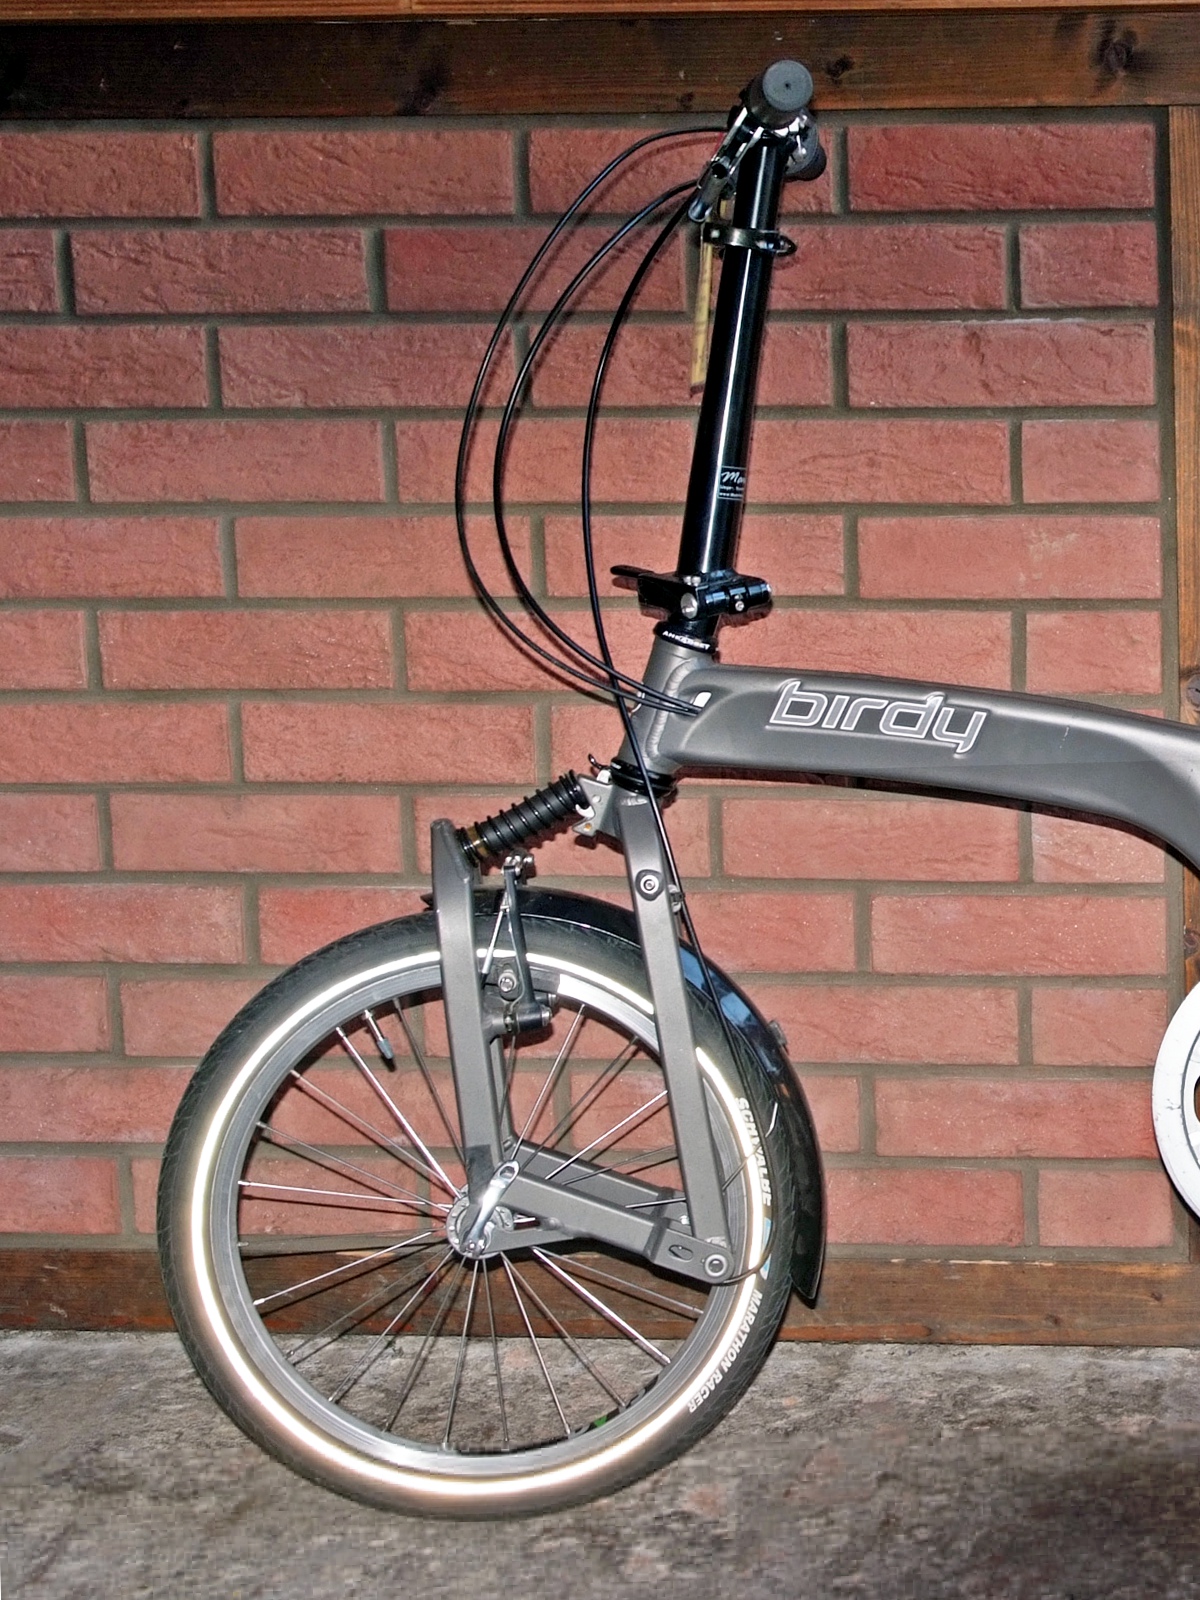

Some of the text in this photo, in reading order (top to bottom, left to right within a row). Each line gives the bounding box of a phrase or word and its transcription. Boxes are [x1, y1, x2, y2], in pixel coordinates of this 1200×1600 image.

[769, 680, 988, 754] birdy
[687, 1288, 763, 1413] MARATHON RACER
